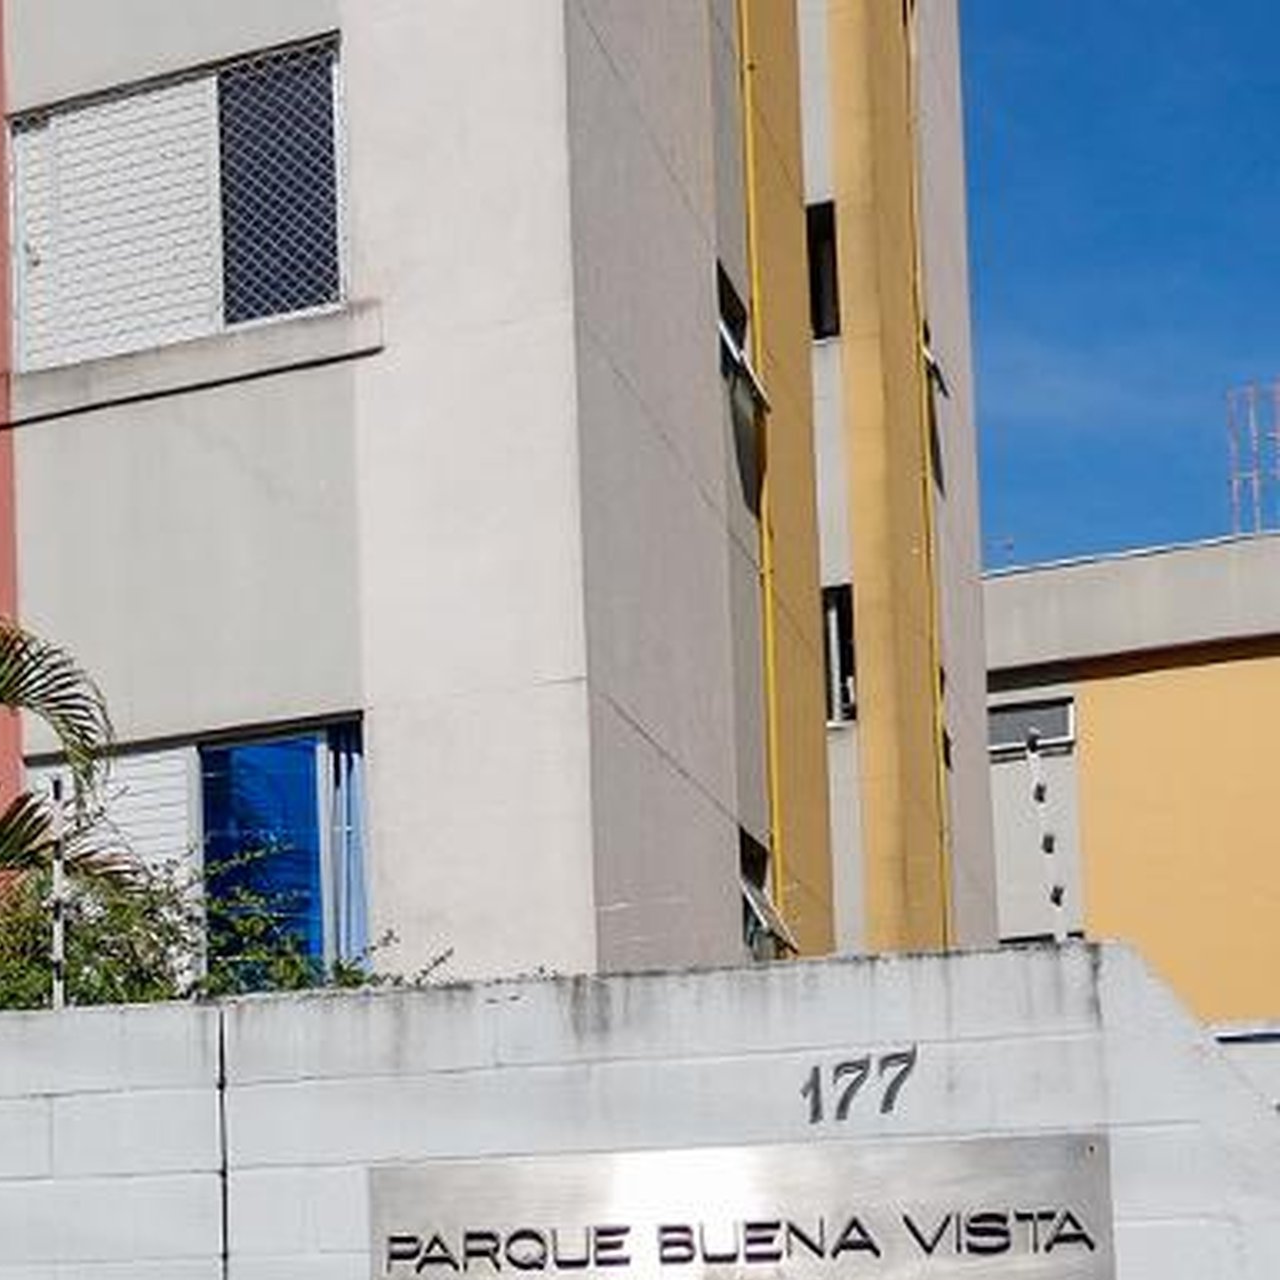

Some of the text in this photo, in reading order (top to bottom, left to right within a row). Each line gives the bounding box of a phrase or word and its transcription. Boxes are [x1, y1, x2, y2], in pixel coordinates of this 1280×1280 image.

[800, 1043, 917, 1124] 177
[386, 1211, 1095, 1274] PARQUE BUENA VISTA
